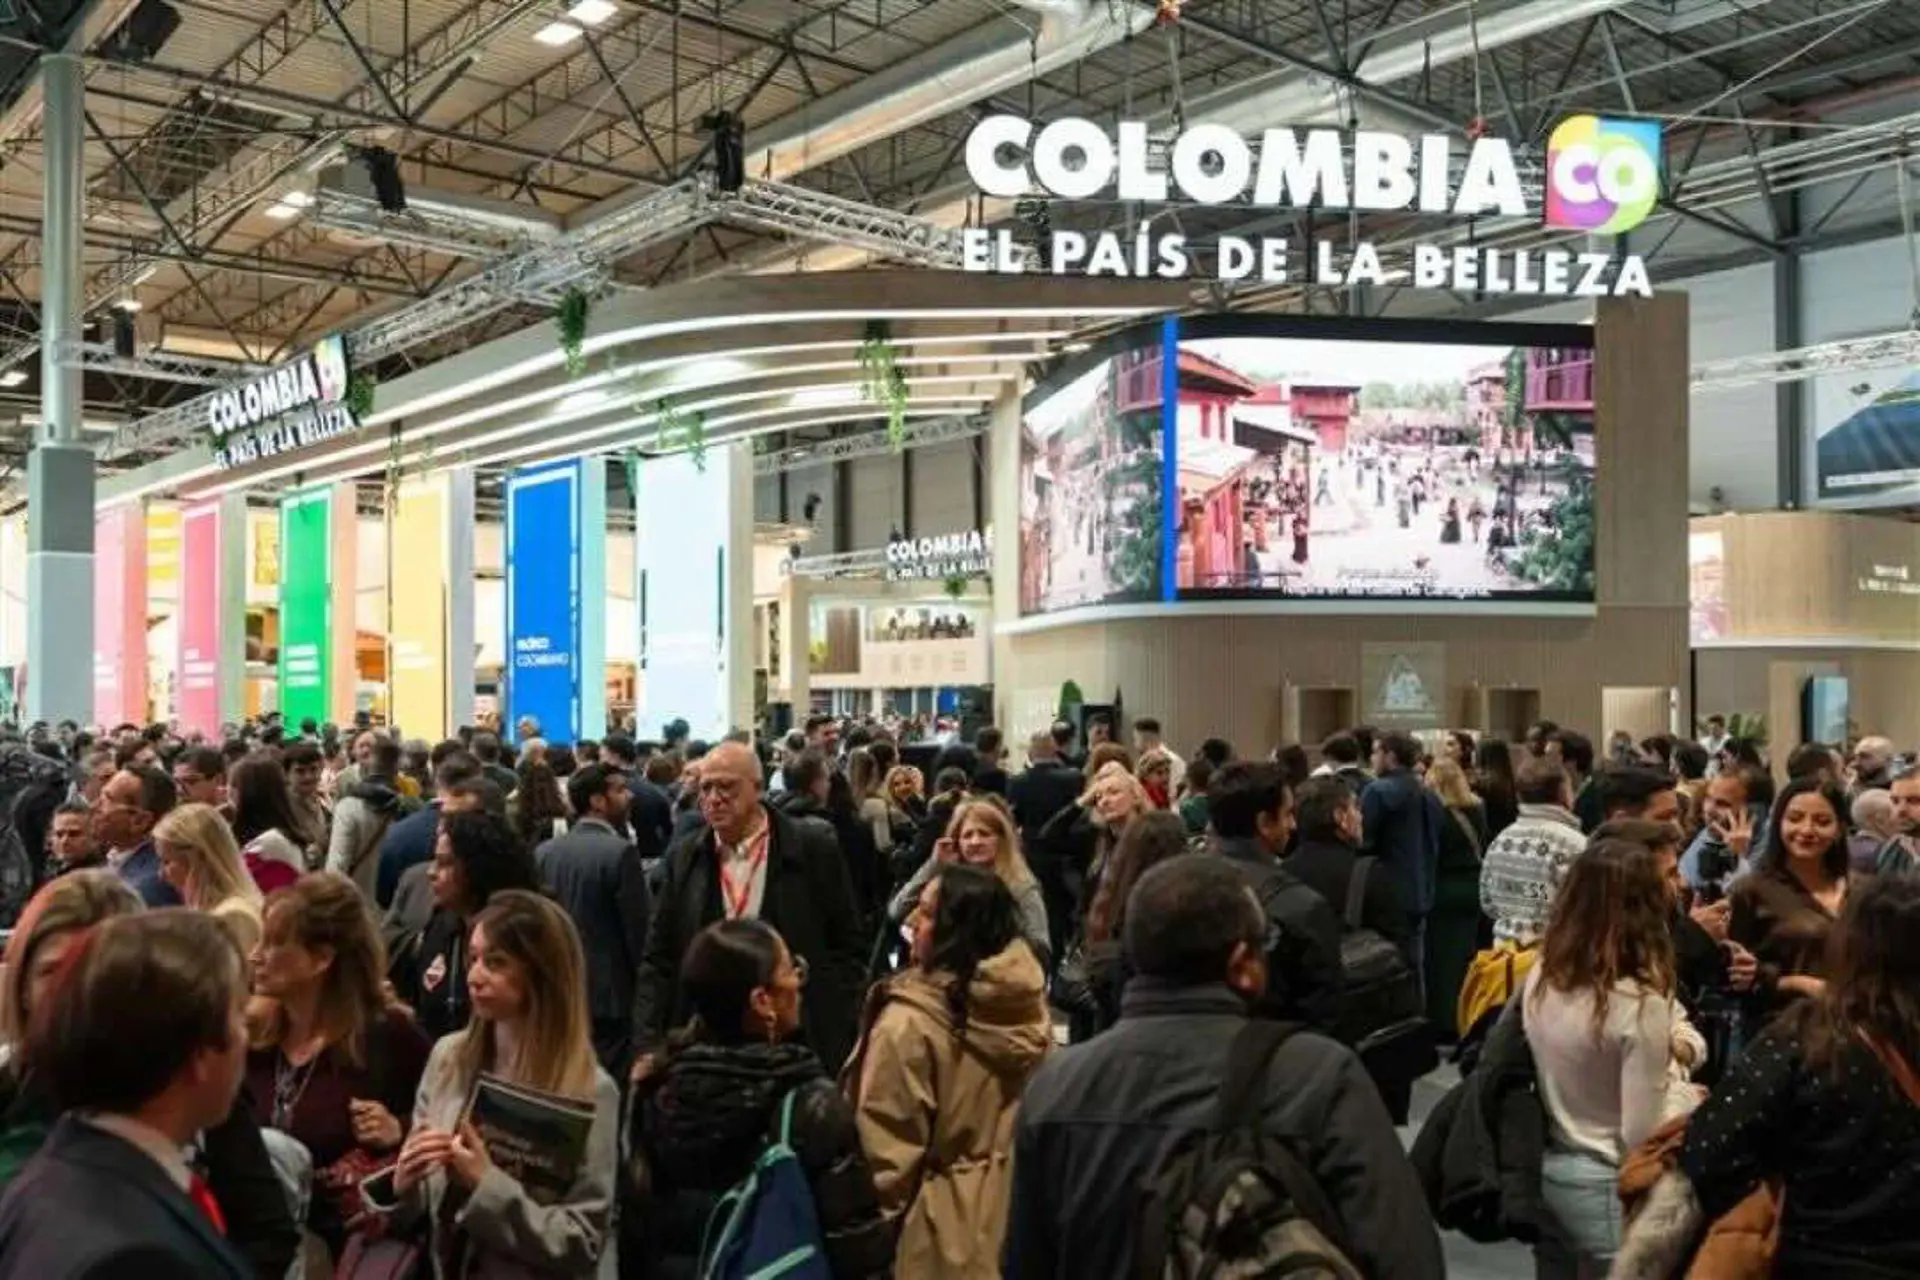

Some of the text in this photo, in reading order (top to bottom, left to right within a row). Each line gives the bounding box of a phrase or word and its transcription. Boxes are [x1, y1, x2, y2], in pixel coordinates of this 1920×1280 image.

[965, 114, 1658, 216] COLOMBIA CO
[964, 221, 1653, 297] EL PAÍS DE LA BELLEZA
[209, 357, 320, 436] COLOMBIA
